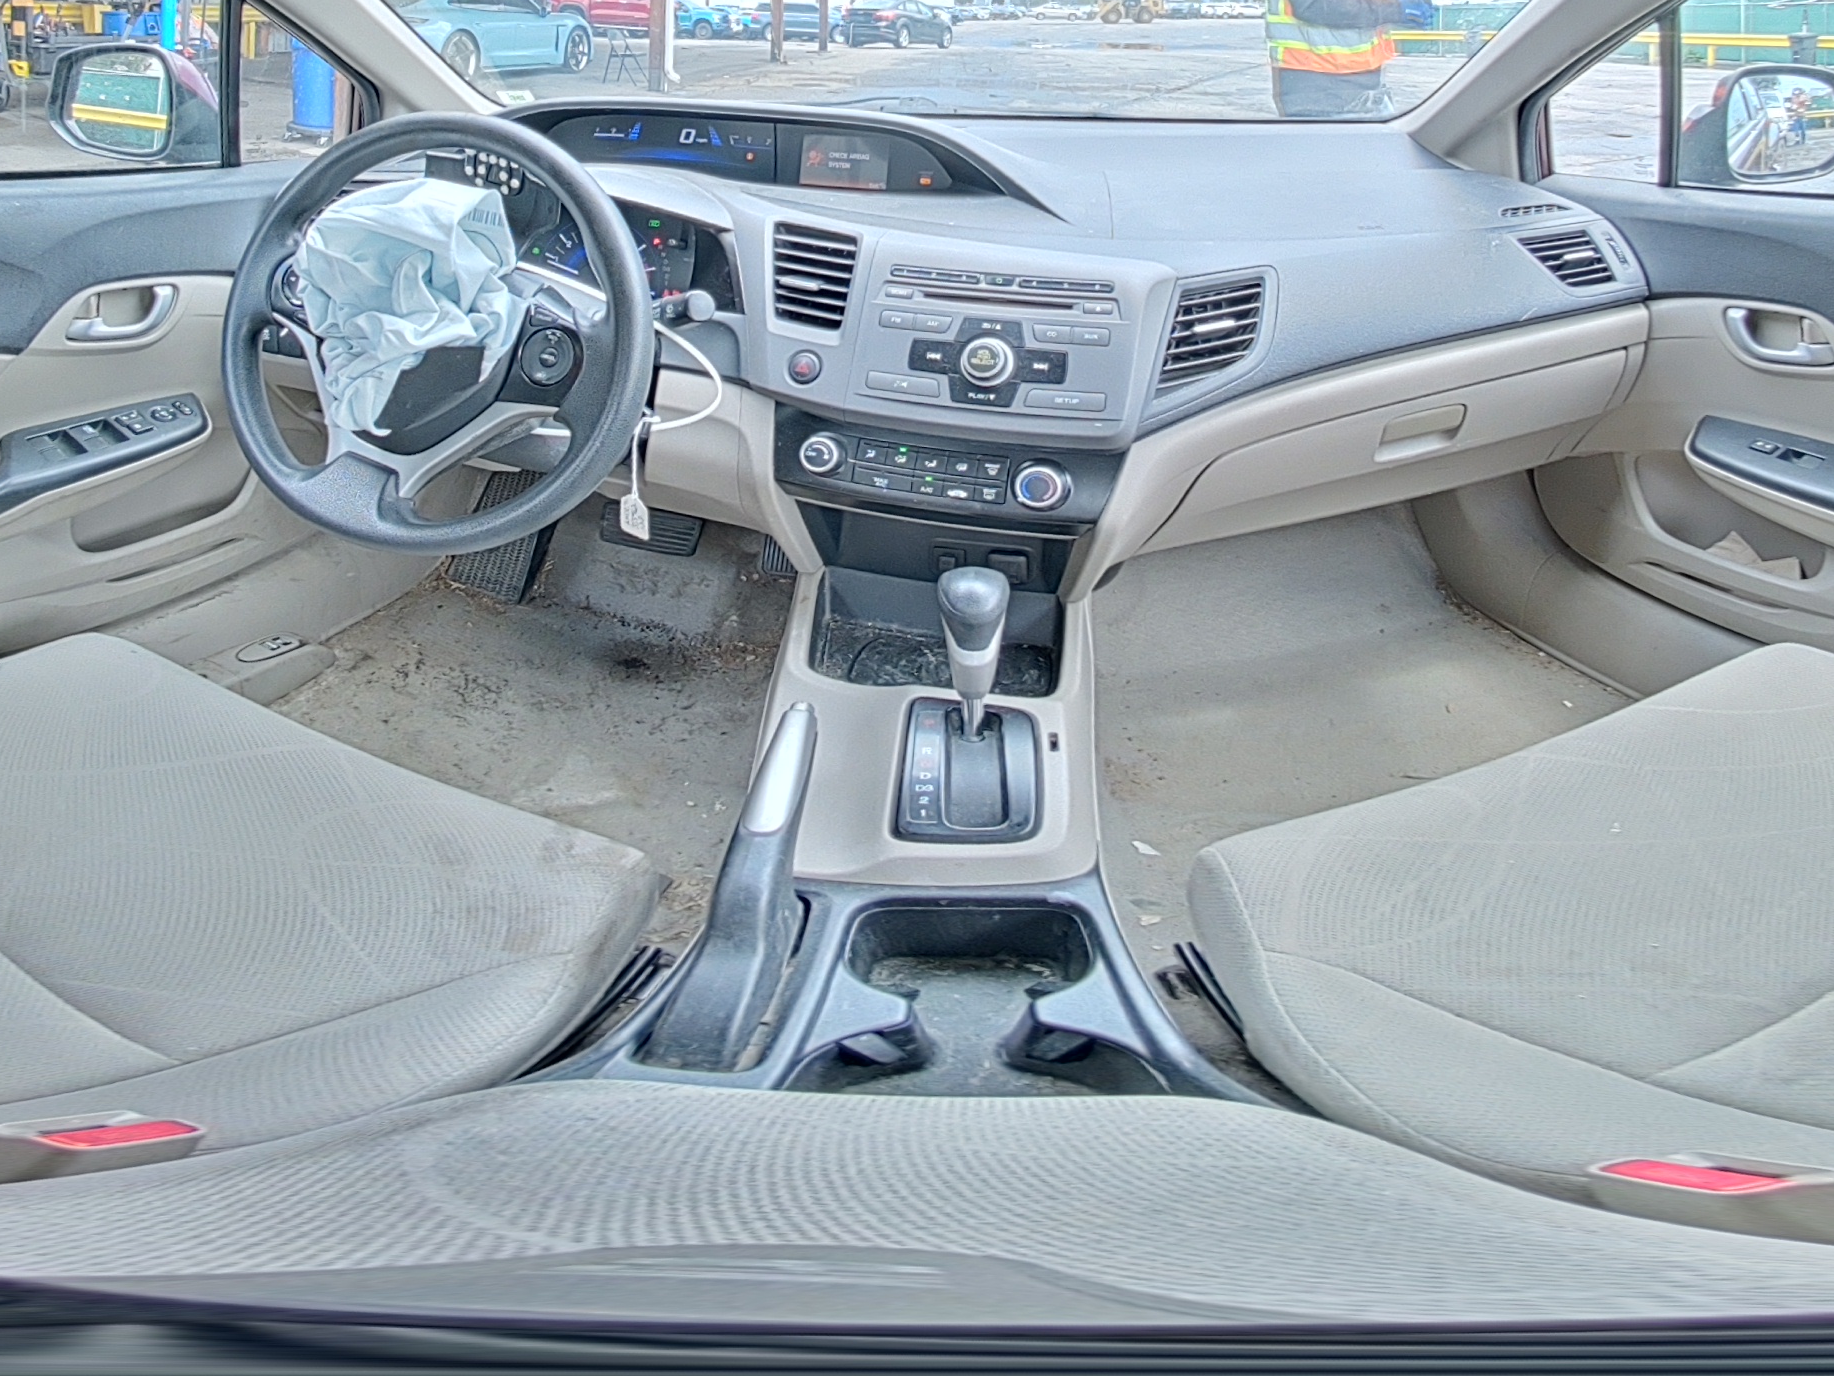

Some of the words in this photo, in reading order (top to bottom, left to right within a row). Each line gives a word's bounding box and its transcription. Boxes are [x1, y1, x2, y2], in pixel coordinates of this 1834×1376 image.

[828, 151, 848, 160] CHECK
[849, 151, 870, 161] AIRBAG
[828, 161, 851, 169] SYSTEM
[891, 316, 902, 324] FM
[1084, 332, 1099, 340] AUX
[1055, 396, 1080, 405] SETUP
[922, 746, 933, 755] R
[919, 772, 931, 780] D
[915, 784, 934, 792] D3
[918, 796, 929, 804] 2
